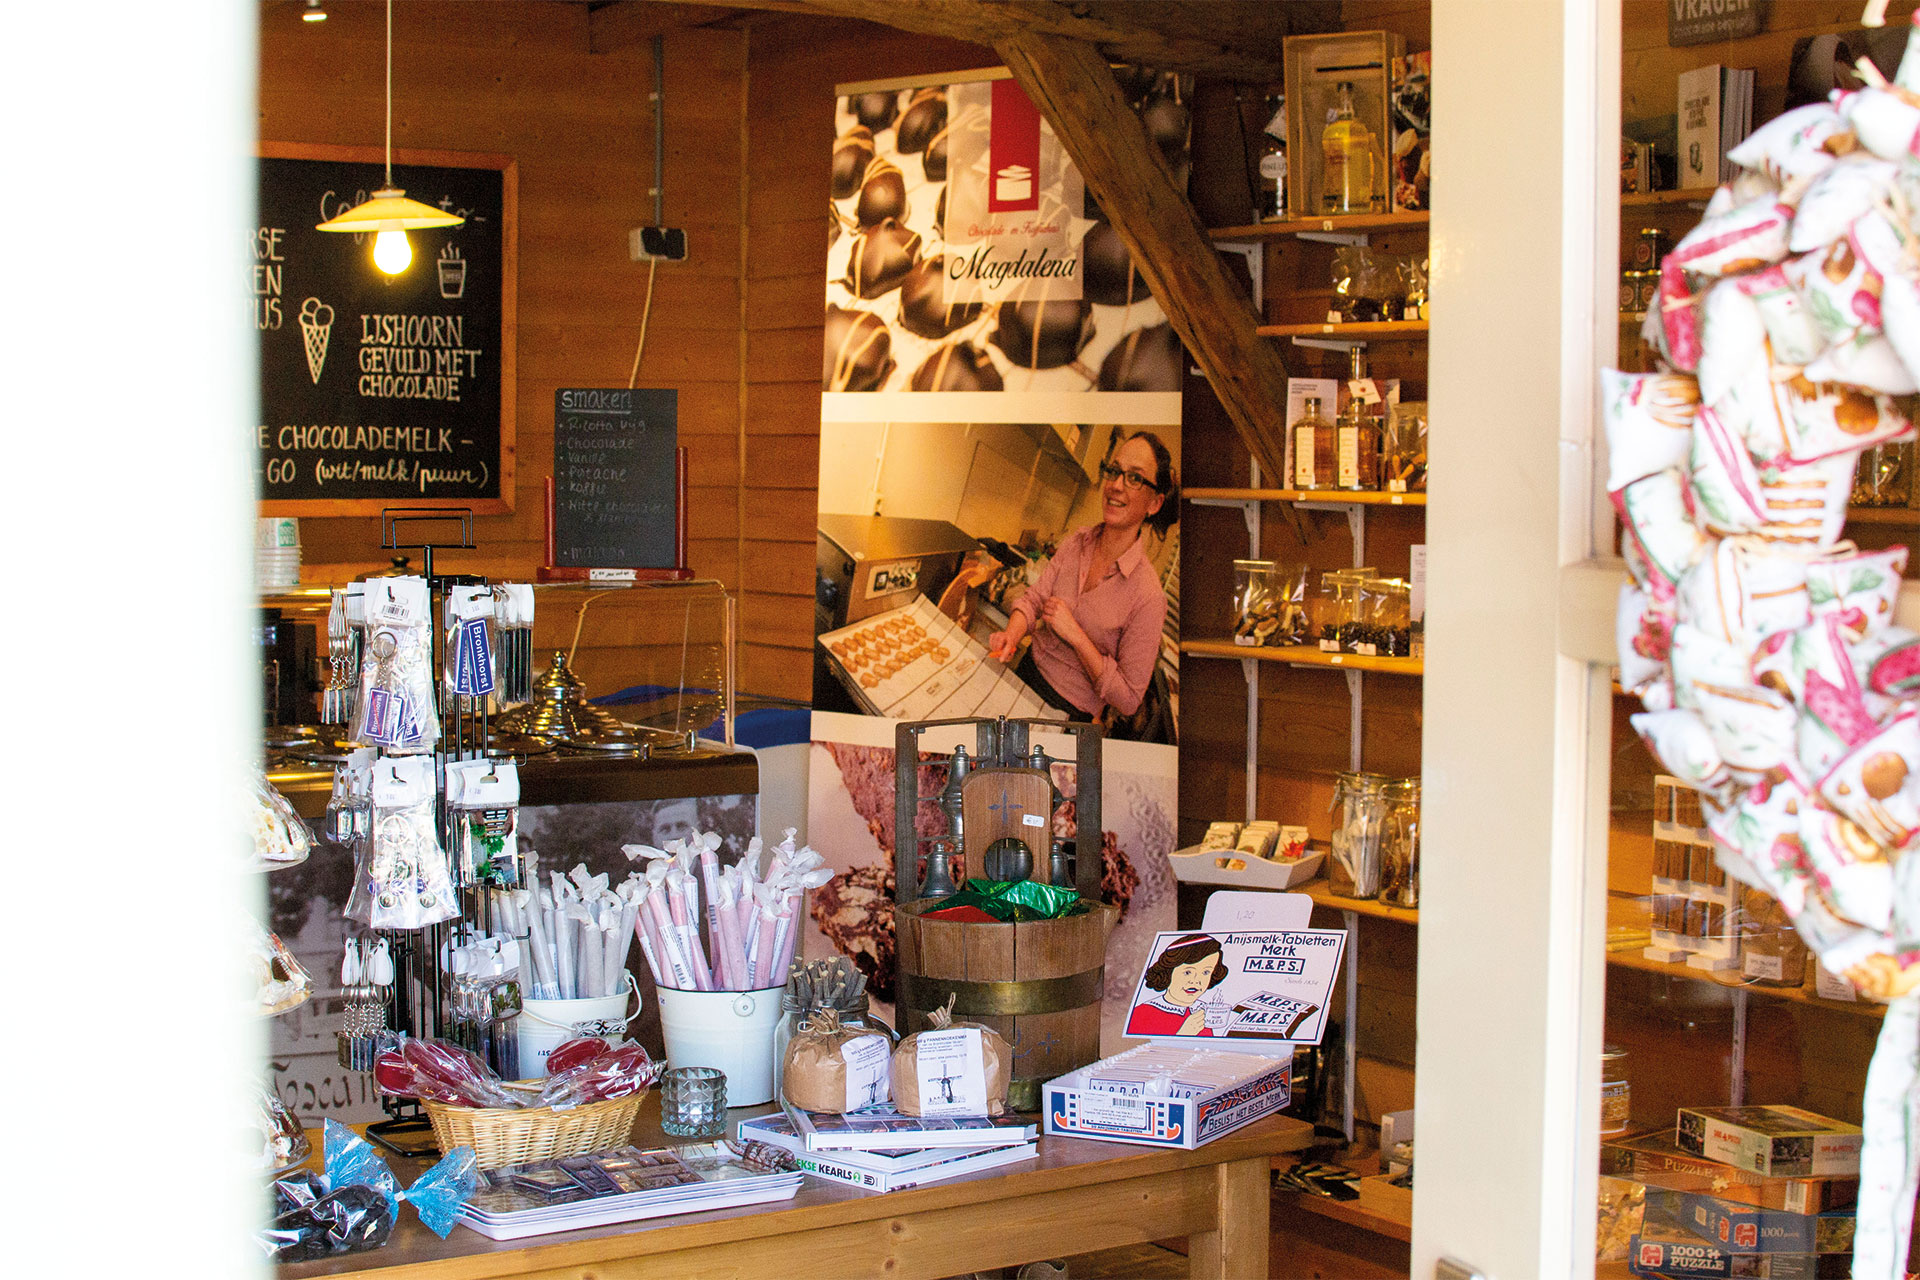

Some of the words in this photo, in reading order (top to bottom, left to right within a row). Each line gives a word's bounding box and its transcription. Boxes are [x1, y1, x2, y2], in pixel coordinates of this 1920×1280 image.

[950, 245, 1077, 289] Magdalena
[360, 314, 463, 348] IJSHOORN
[358, 346, 430, 374] GEVULD
[435, 349, 482, 379] MET
[358, 374, 461, 402] CHOCOLADE
[278, 425, 453, 453] CHOCOLADEMELK
[473, 626, 489, 688] Bronkhorst
[1224, 932, 1337, 947] Anijsmelk-Tabletten
[1260, 944, 1297, 956] Merk
[1209, 1112, 1234, 1132] BESLIST
[1236, 1106, 1248, 1120] HET
[1248, 1100, 1264, 1115] BESTE
[819, 1163, 853, 1180] KEARLS
[1663, 1157, 1714, 1178] PUZZLE
[1761, 1228, 1783, 1238] 1000
[1669, 1256, 1725, 1271] PUZZLE
[1671, 1245, 1705, 1258] 1000
